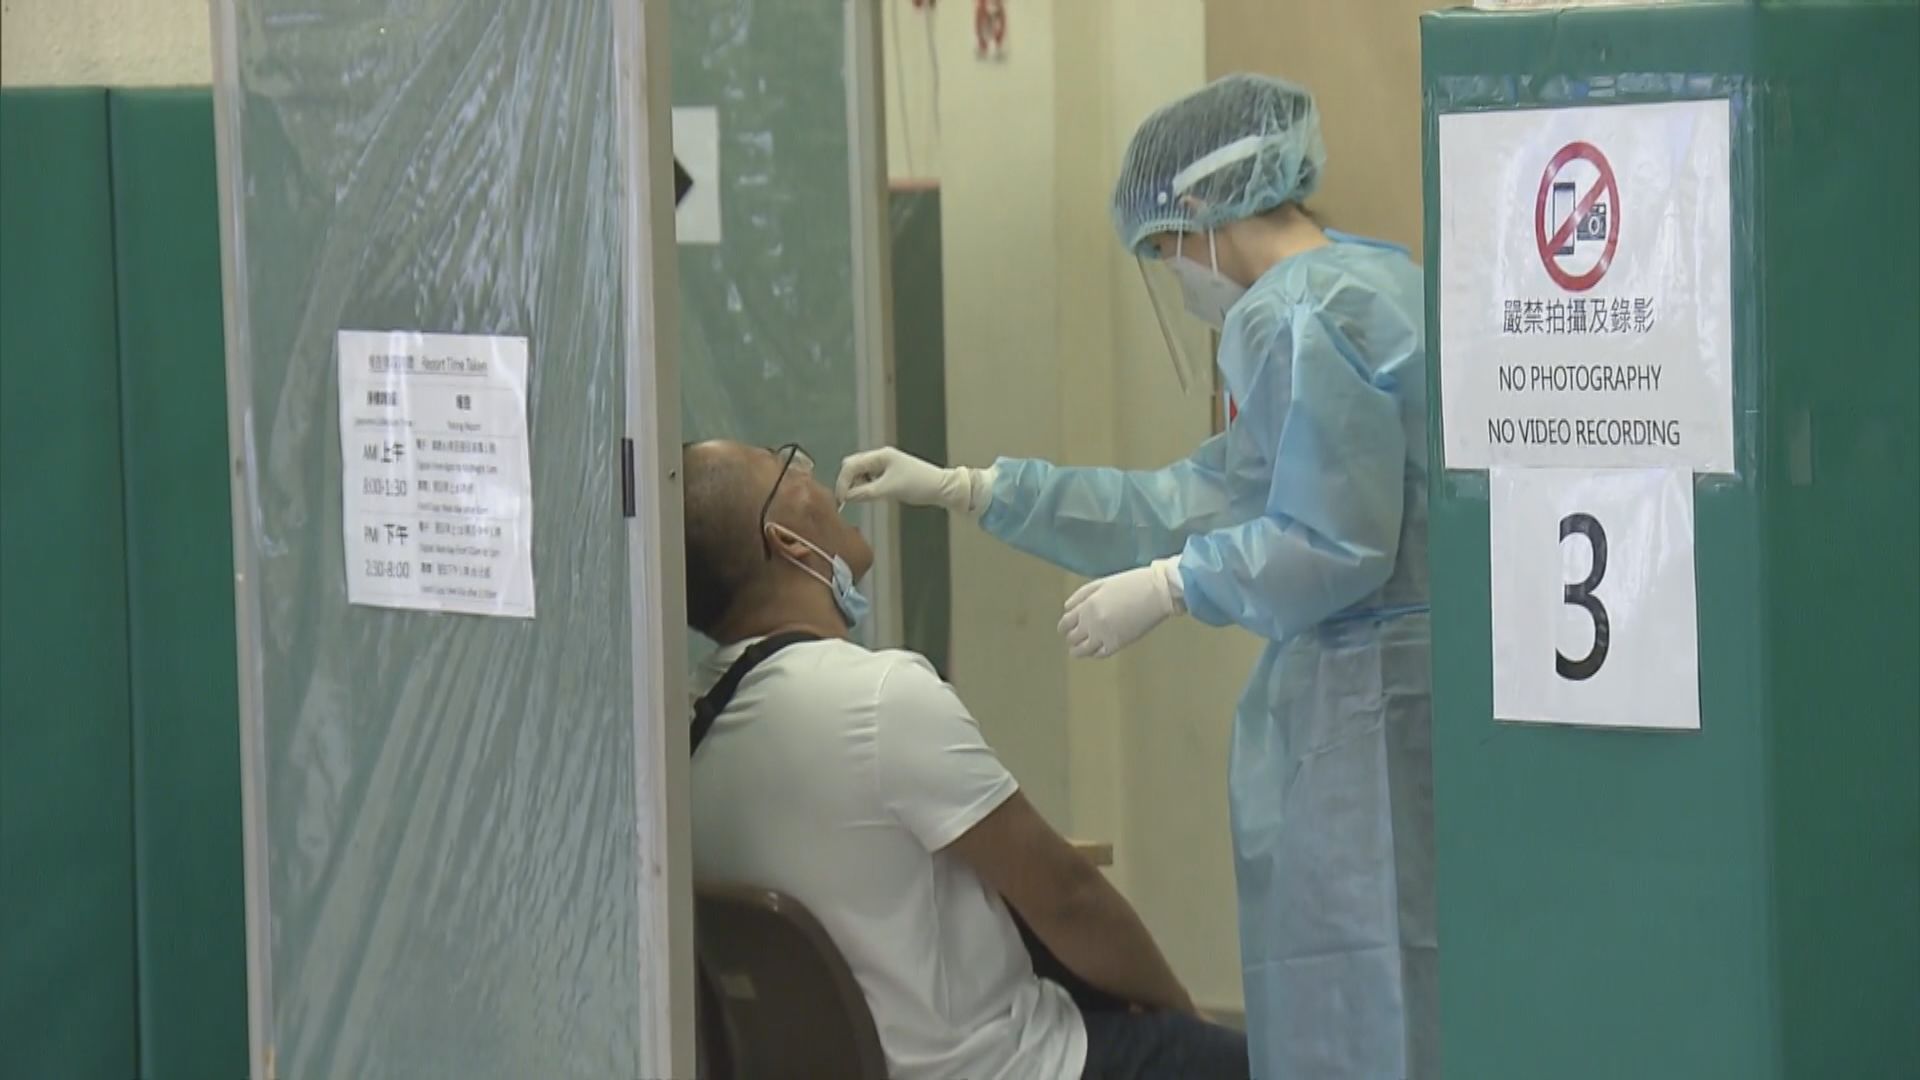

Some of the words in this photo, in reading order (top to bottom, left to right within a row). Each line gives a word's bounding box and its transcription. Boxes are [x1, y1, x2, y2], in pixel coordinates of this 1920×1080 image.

[1503, 297, 1654, 334] 嚴禁拍攝及錄影
[447, 357, 464, 371] Time
[1499, 366, 1526, 391] NO
[1531, 365, 1661, 391] PHOTOGRAPHY
[1488, 418, 1514, 444] NO
[1519, 419, 1571, 445] VIDEO
[1576, 420, 1680, 445] RECORDING
[364, 444, 377, 460] AM
[381, 441, 404, 463] 上午
[364, 526, 378, 543] PM
[384, 524, 408, 545] 下午
[1555, 512, 1610, 681] 3
